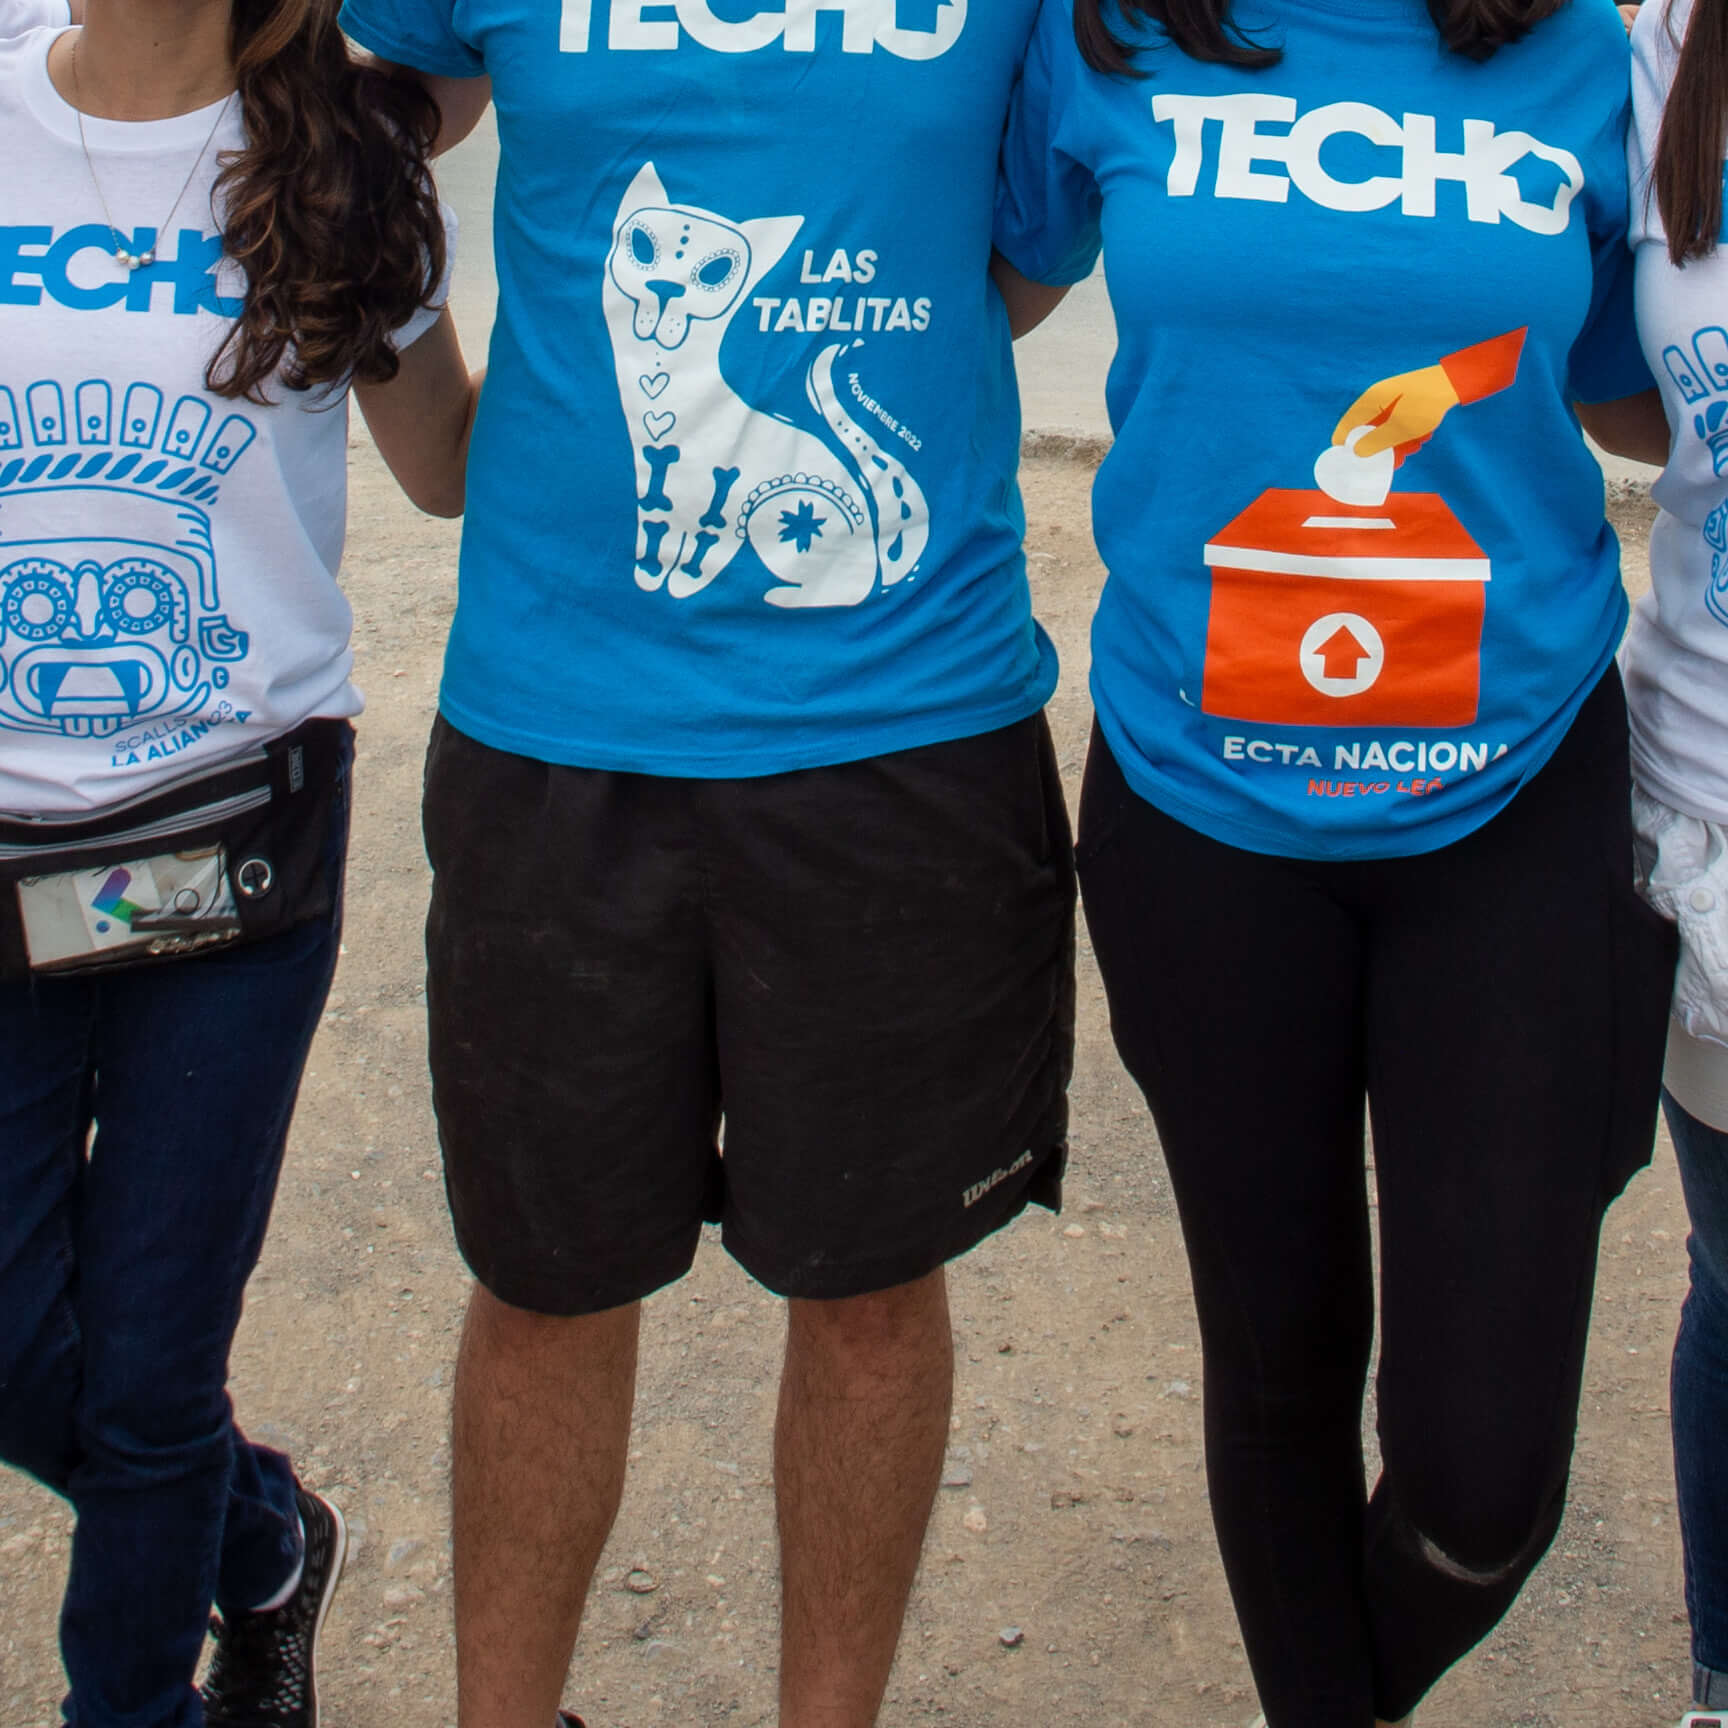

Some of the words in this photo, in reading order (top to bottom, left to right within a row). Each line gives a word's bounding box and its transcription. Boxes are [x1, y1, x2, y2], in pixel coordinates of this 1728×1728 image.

[1152, 93, 1584, 236] TECHO
[800, 249, 878, 284] LAS
[753, 296, 933, 332] TABLITAS
[848, 372, 899, 432] NOVIEMBRE
[897, 426, 922, 451] 2022
[112, 752, 140, 767] LA
[1307, 778, 1390, 797] NUEVO
